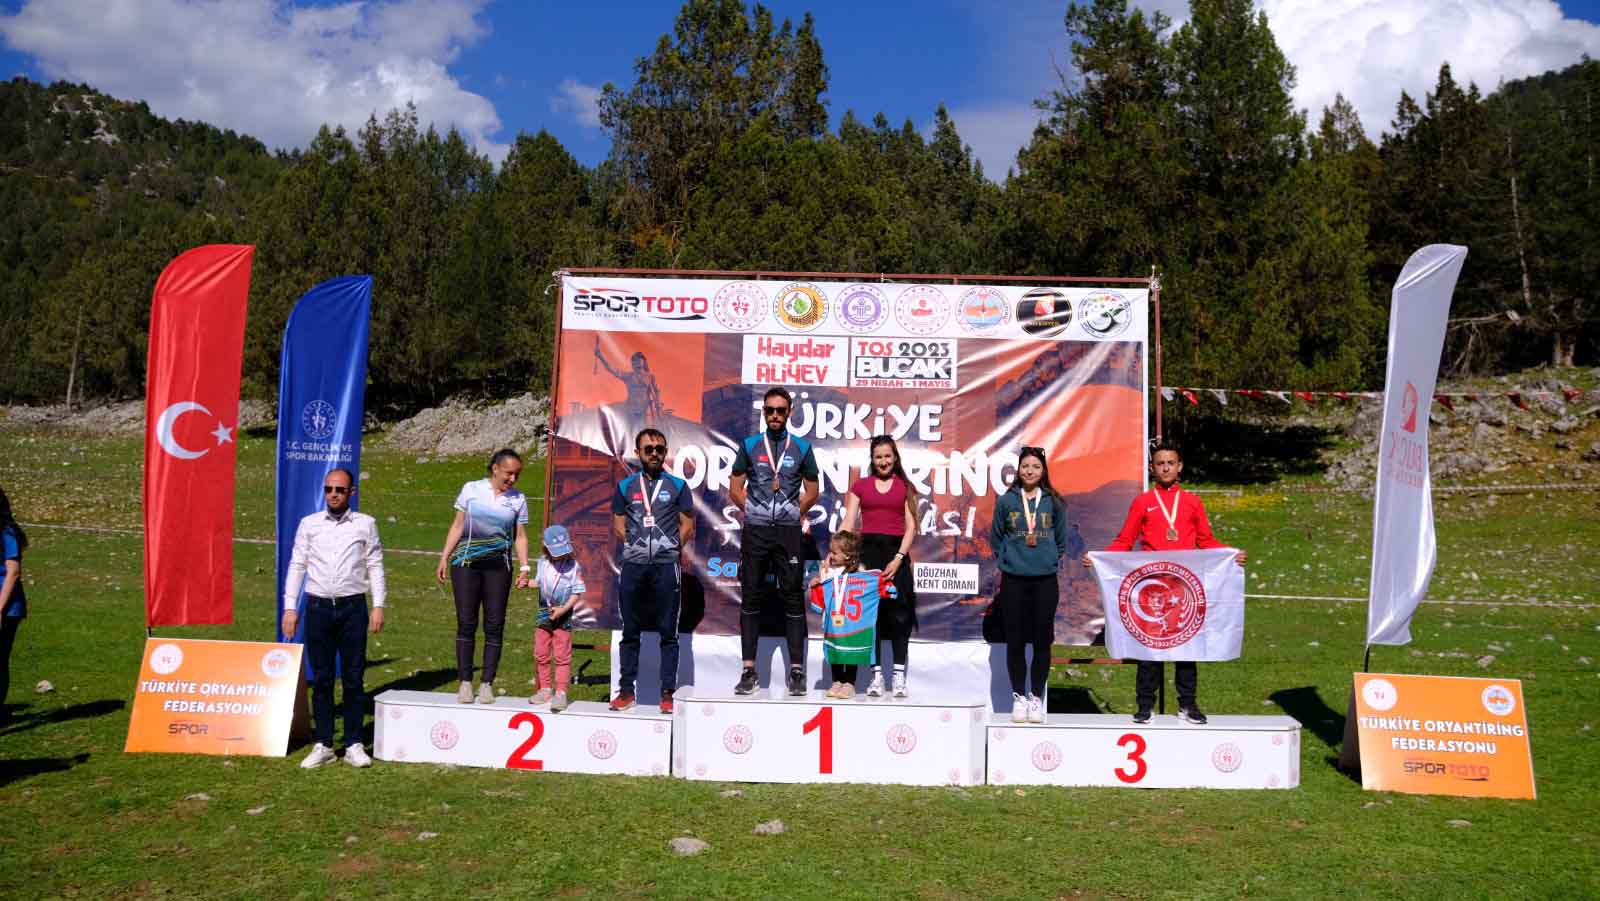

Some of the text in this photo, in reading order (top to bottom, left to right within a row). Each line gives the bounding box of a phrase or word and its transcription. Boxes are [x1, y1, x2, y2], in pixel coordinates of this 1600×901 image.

[574, 295, 709, 314] SPOR TOTO
[757, 337, 836, 363] Haydar
[858, 341, 950, 357] TOS 2023
[856, 357, 951, 379] BUCAK
[856, 379, 868, 387] 29
[342, 443, 353, 452] VE
[917, 565, 958, 578] OĞUZHAN
[916, 579, 976, 590] KENT ORMANI
[140, 679, 197, 695] TÜRKİYE
[168, 723, 209, 735] SPOR
[1359, 715, 1524, 737] TÜRKİYE ORYANTİRİNG
[505, 711, 545, 770] 2
[802, 706, 833, 774] 1
[1391, 737, 1497, 755] FEDERASYONU
[1114, 733, 1147, 783] 3
[1403, 761, 1446, 775] SPOR
